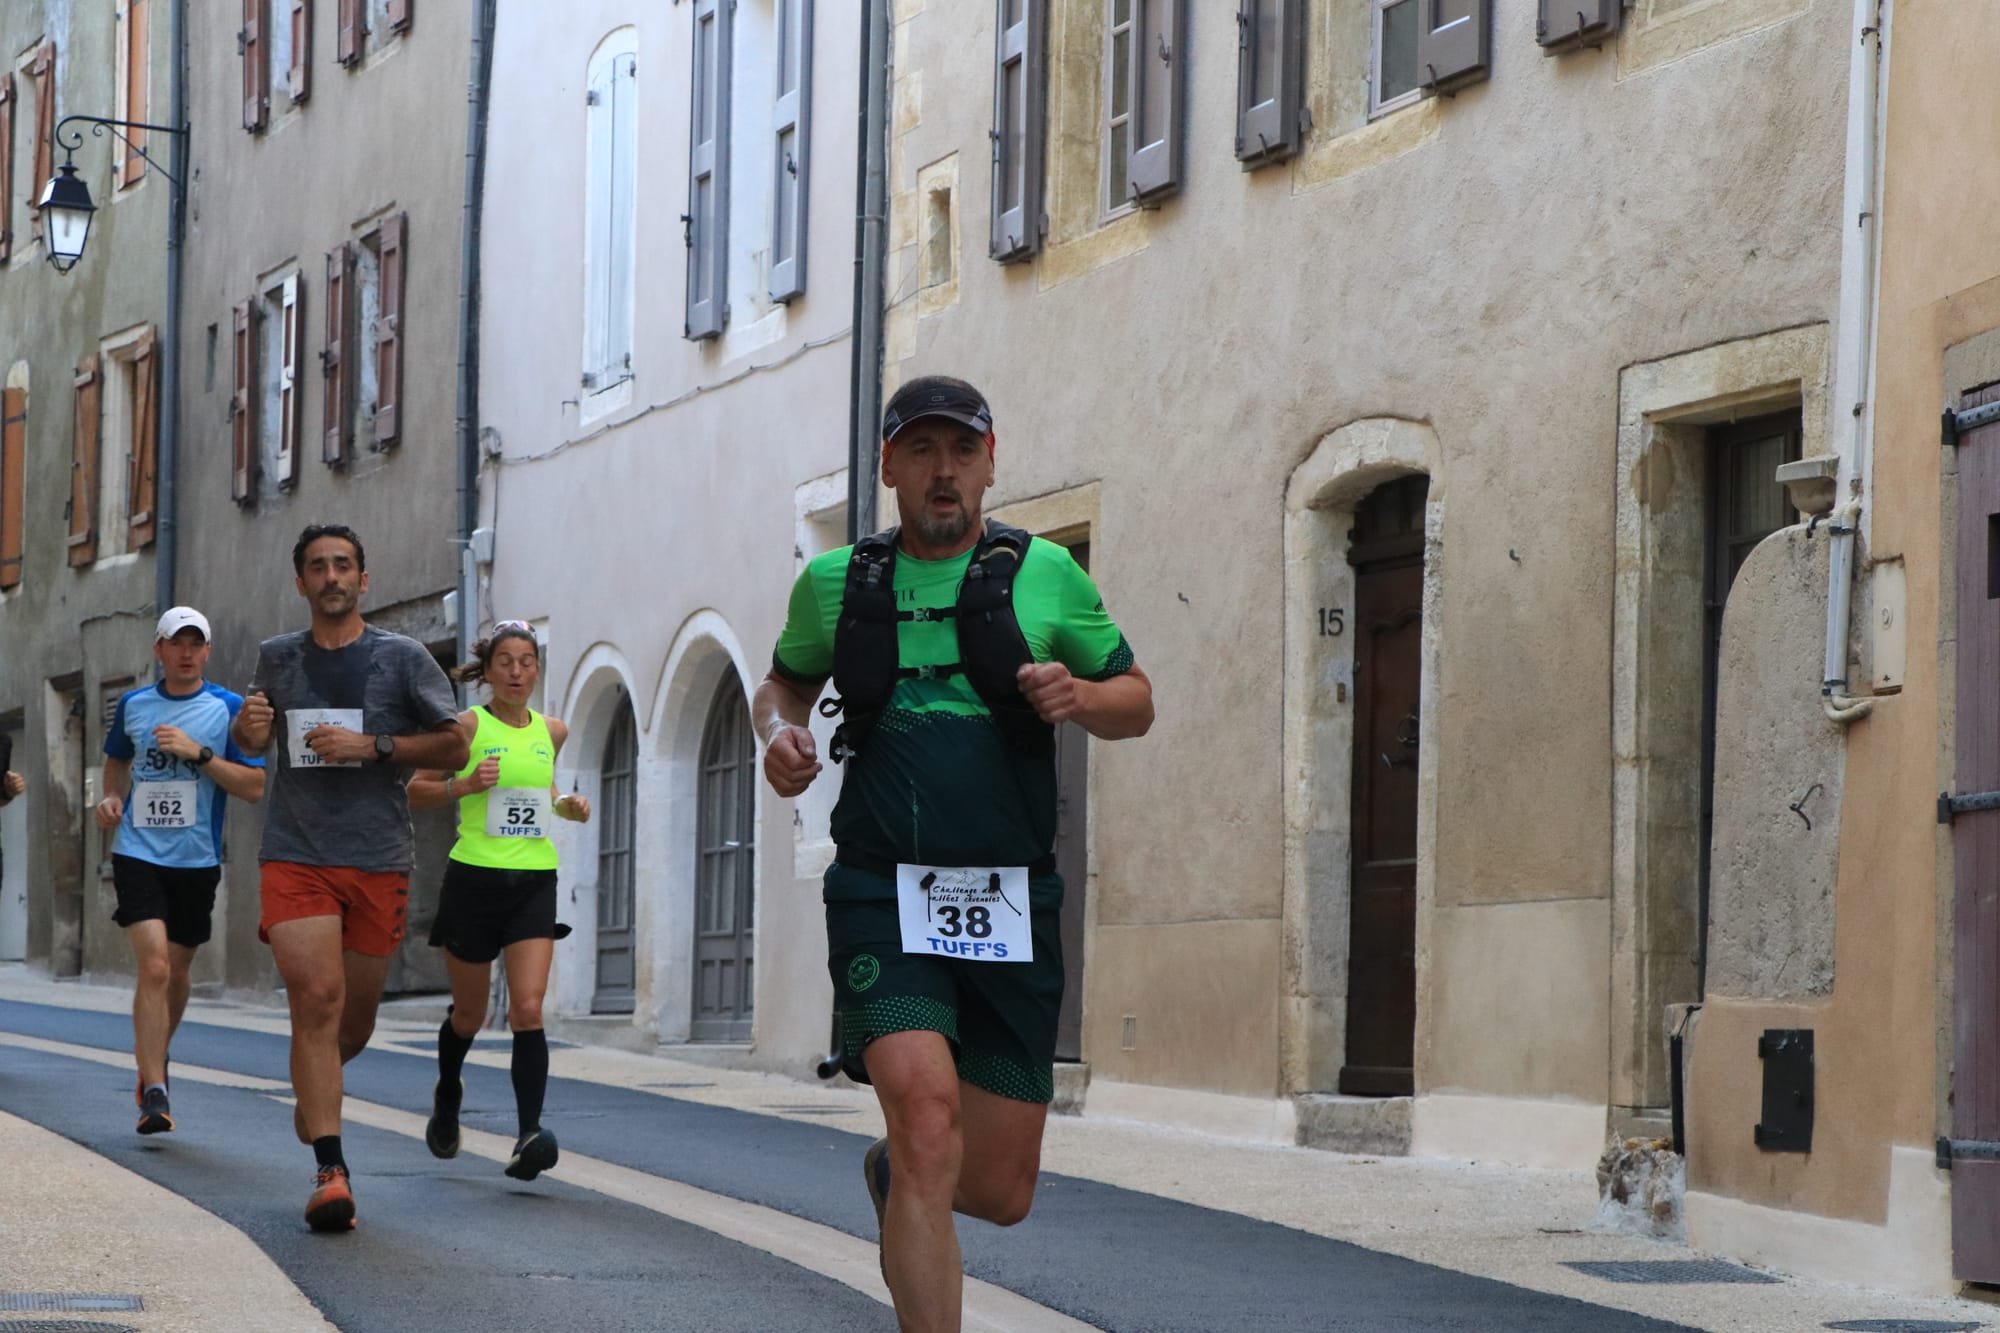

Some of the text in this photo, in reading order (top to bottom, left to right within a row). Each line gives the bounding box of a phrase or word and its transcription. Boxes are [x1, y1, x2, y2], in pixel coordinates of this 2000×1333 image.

[1318, 607, 1344, 636] 15
[147, 801, 182, 815] 162
[506, 807, 535, 825] 52
[146, 817, 185, 826] TUFF'S
[499, 826, 541, 836] TUFF'S
[933, 886, 977, 895] Challenge
[936, 905, 992, 939] 38
[926, 937, 1008, 958] TUFF'S
